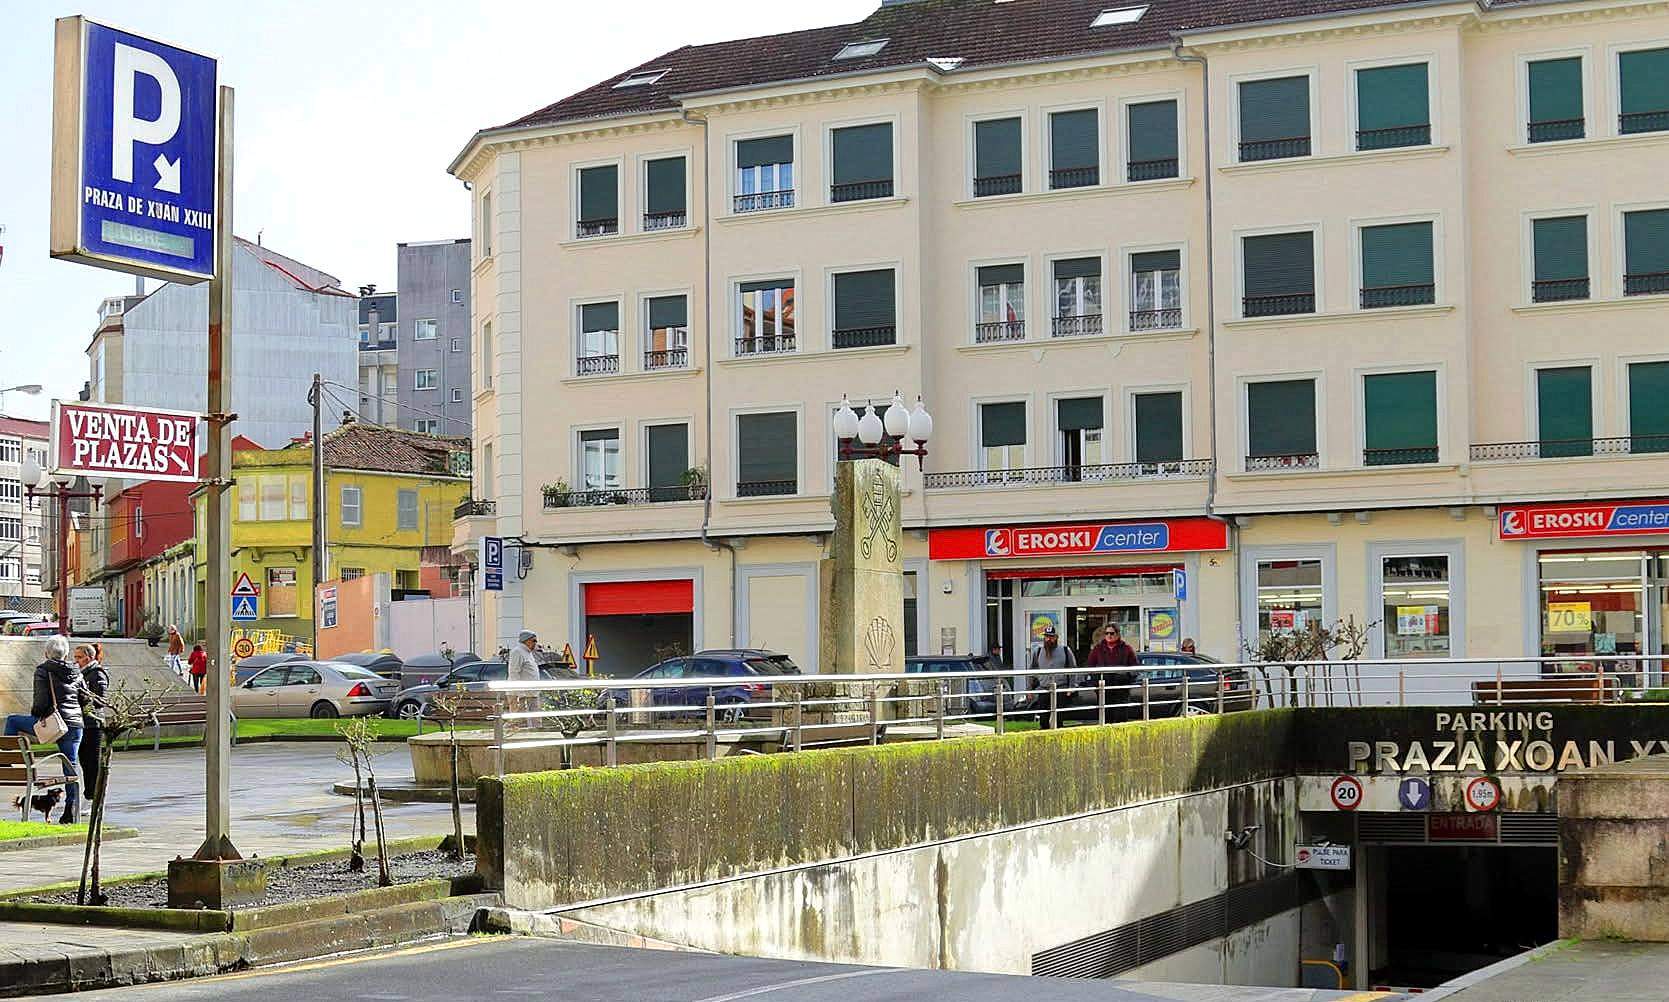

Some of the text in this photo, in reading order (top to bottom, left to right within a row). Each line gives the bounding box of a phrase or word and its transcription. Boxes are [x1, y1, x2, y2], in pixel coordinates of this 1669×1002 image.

[112, 41, 181, 183] P
[85, 186, 212, 229] PRAZA DE XUÁN XXIII
[67, 409, 190, 446] VENTA DE
[72, 438, 169, 472] PLAZAS
[1533, 511, 1669, 528] EROSKI center
[1018, 529, 1160, 549] EROSKI center
[1436, 711, 1554, 731] PARKING
[1349, 740, 1487, 771] PRAZA
[1495, 740, 1616, 771] XOAN
[1337, 786, 1356, 800] 20
[1431, 815, 1495, 832] ENTRADA
